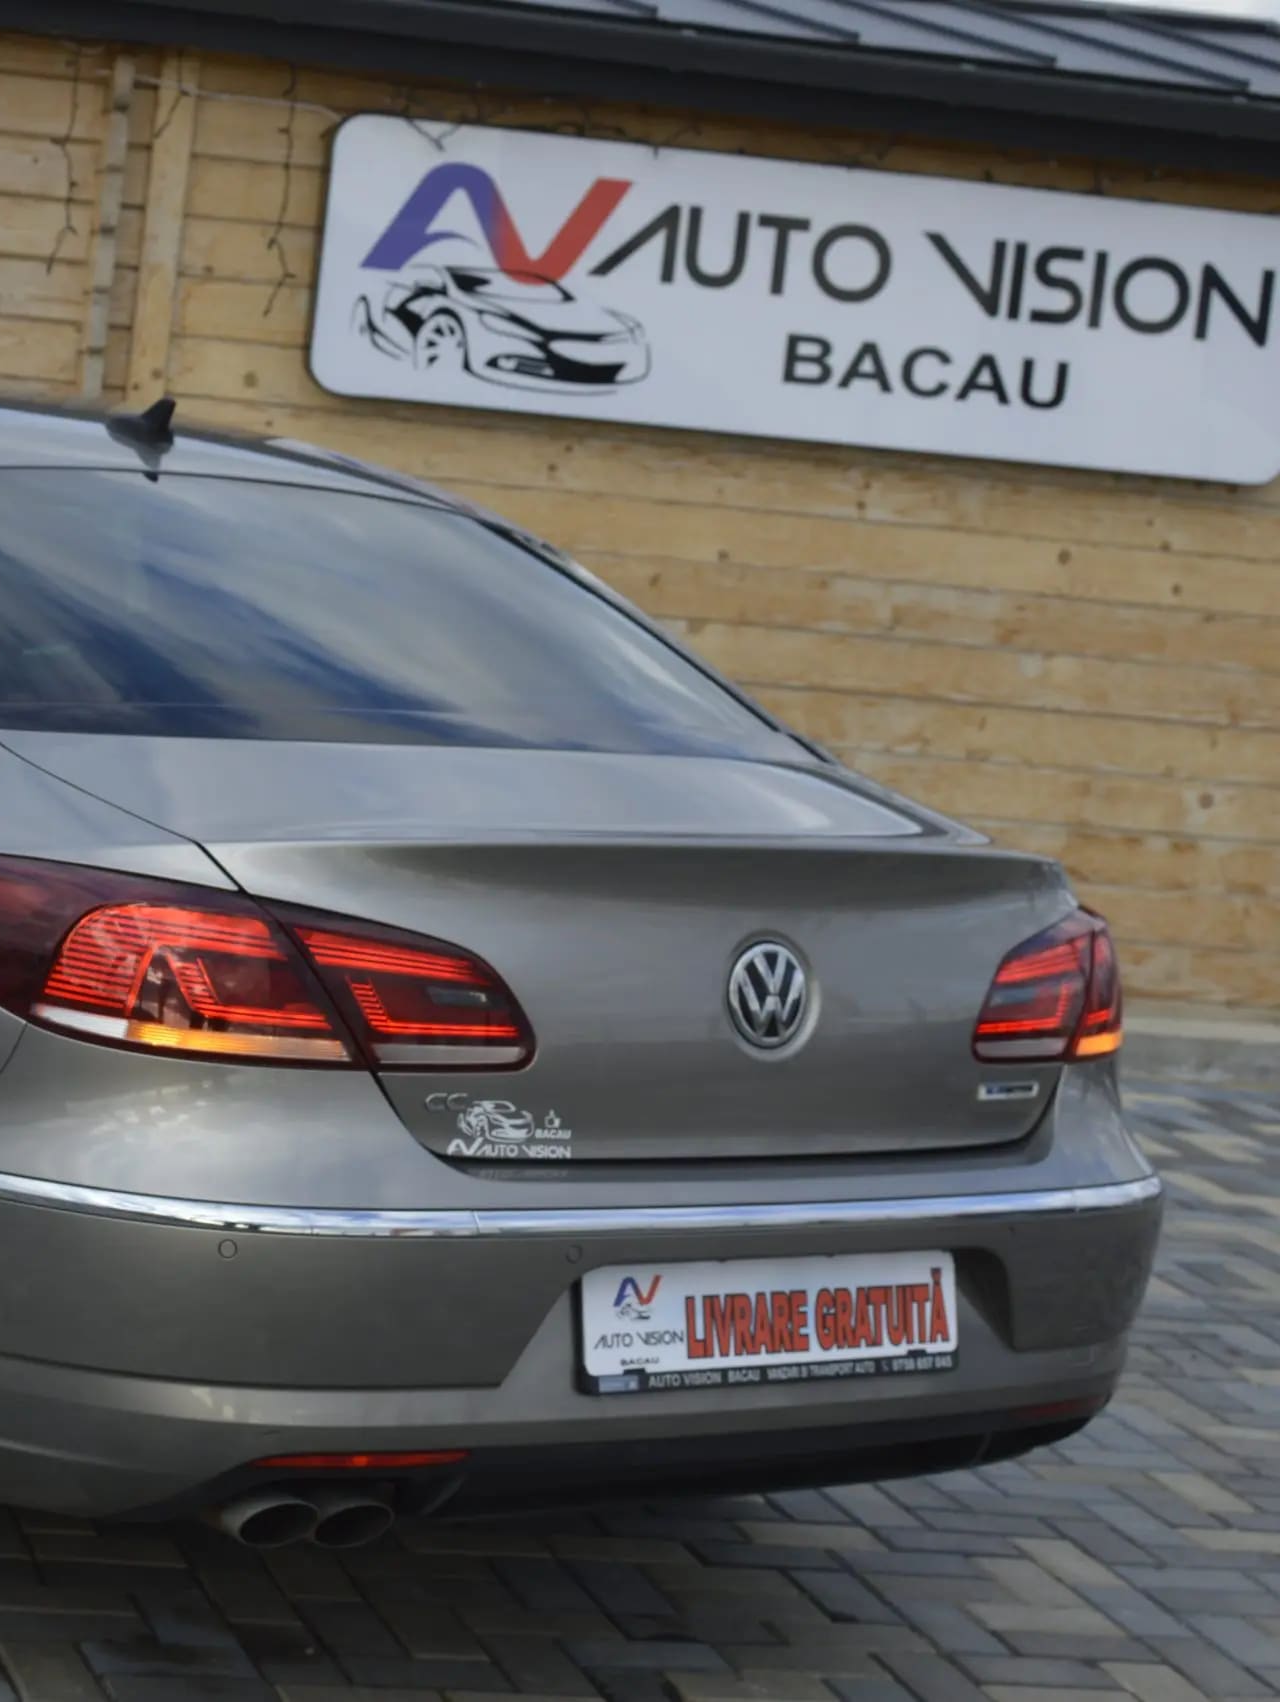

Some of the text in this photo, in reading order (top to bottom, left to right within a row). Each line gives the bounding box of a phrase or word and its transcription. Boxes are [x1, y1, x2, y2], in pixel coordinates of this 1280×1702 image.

[587, 203, 1275, 347] AUTO VISION
[781, 333, 1070, 410] BACAU
[426, 1092, 468, 1110] CC
[522, 1144, 572, 1159] VISION
[685, 1290, 810, 1359] LIVRARE
[593, 1330, 685, 1350] AUTO VISION
[648, 1373, 681, 1388] AUTO
